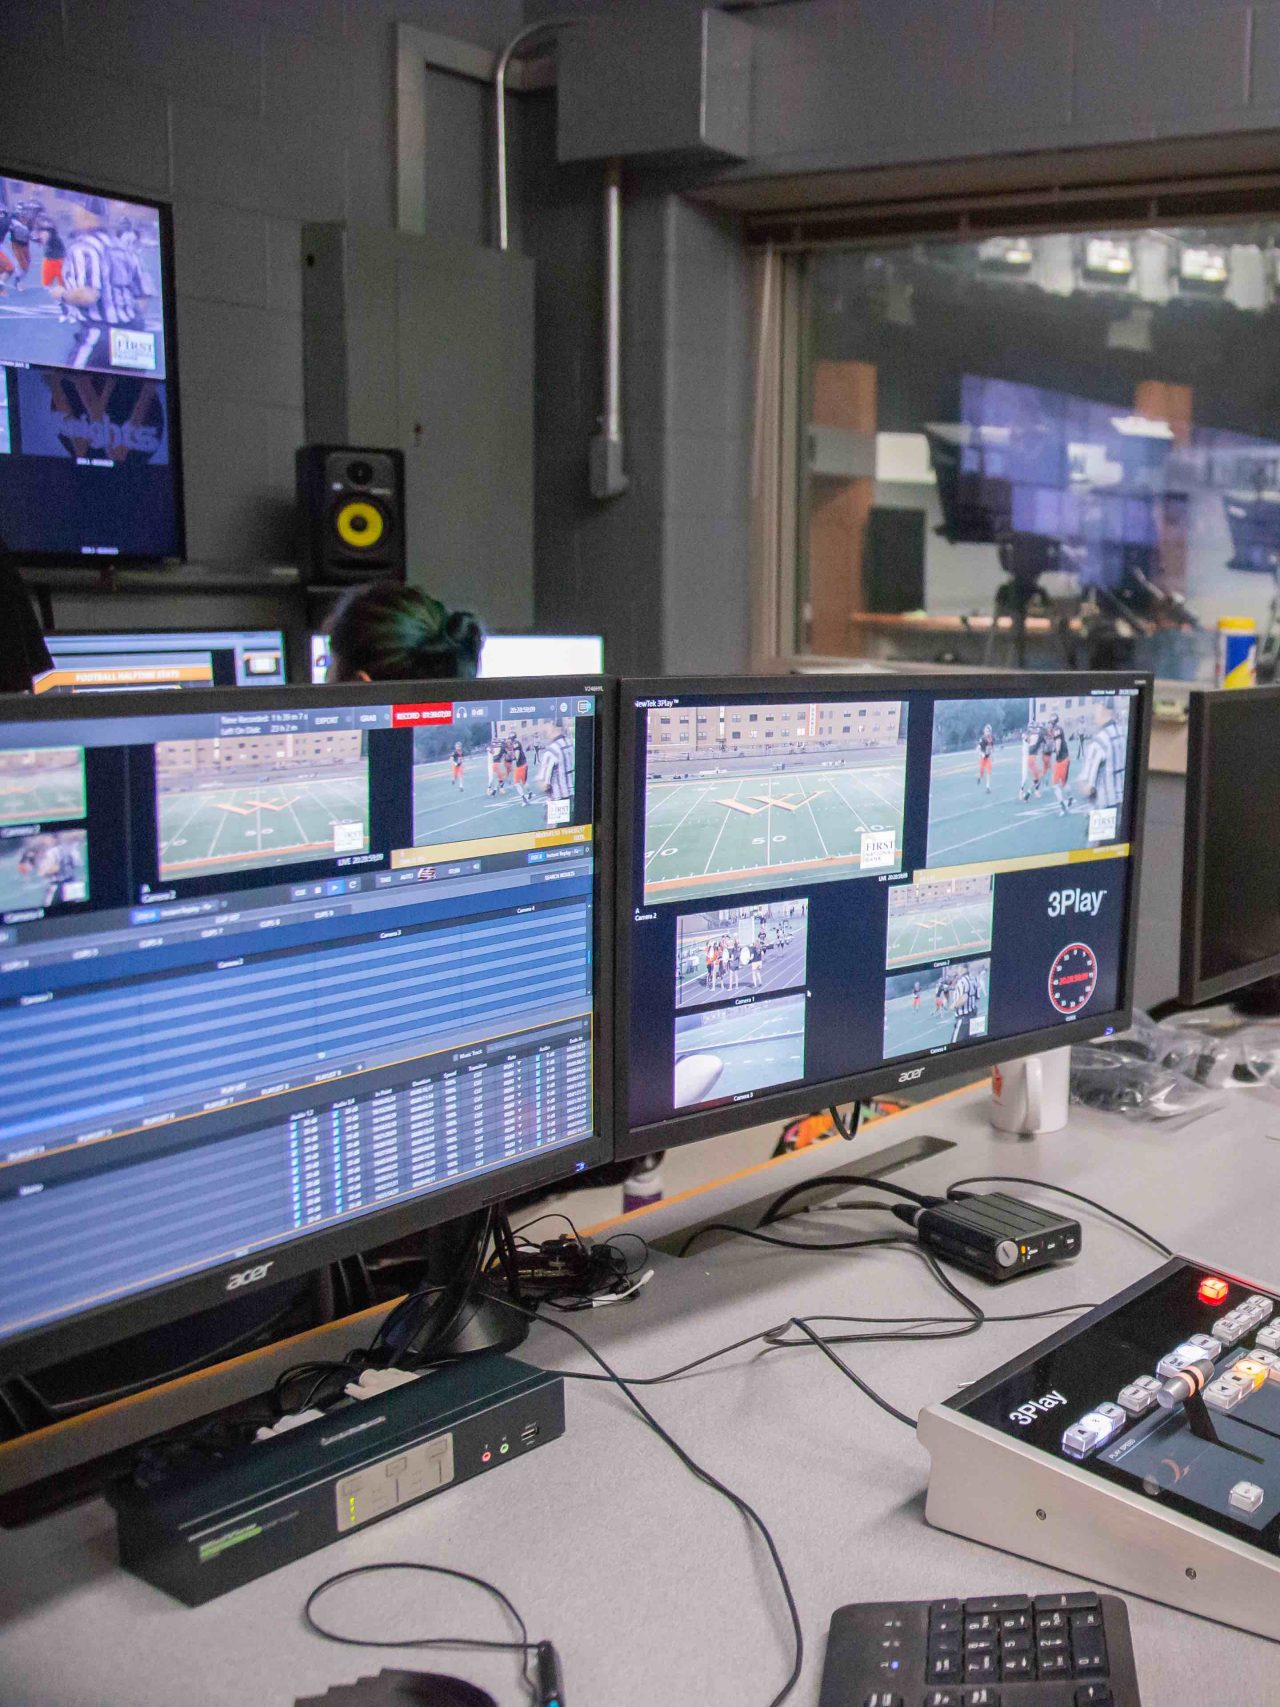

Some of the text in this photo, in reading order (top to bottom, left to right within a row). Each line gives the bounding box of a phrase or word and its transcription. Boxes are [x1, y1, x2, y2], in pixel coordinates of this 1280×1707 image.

[866, 840, 893, 851] FIRST
[1047, 888, 1103, 917] 3Play
[635, 914, 652, 922] Camera
[898, 1067, 926, 1082] acer
[734, 1094, 749, 1102] Camera
[226, 1260, 275, 1291] acer
[1008, 1390, 1068, 1426] 3Play
